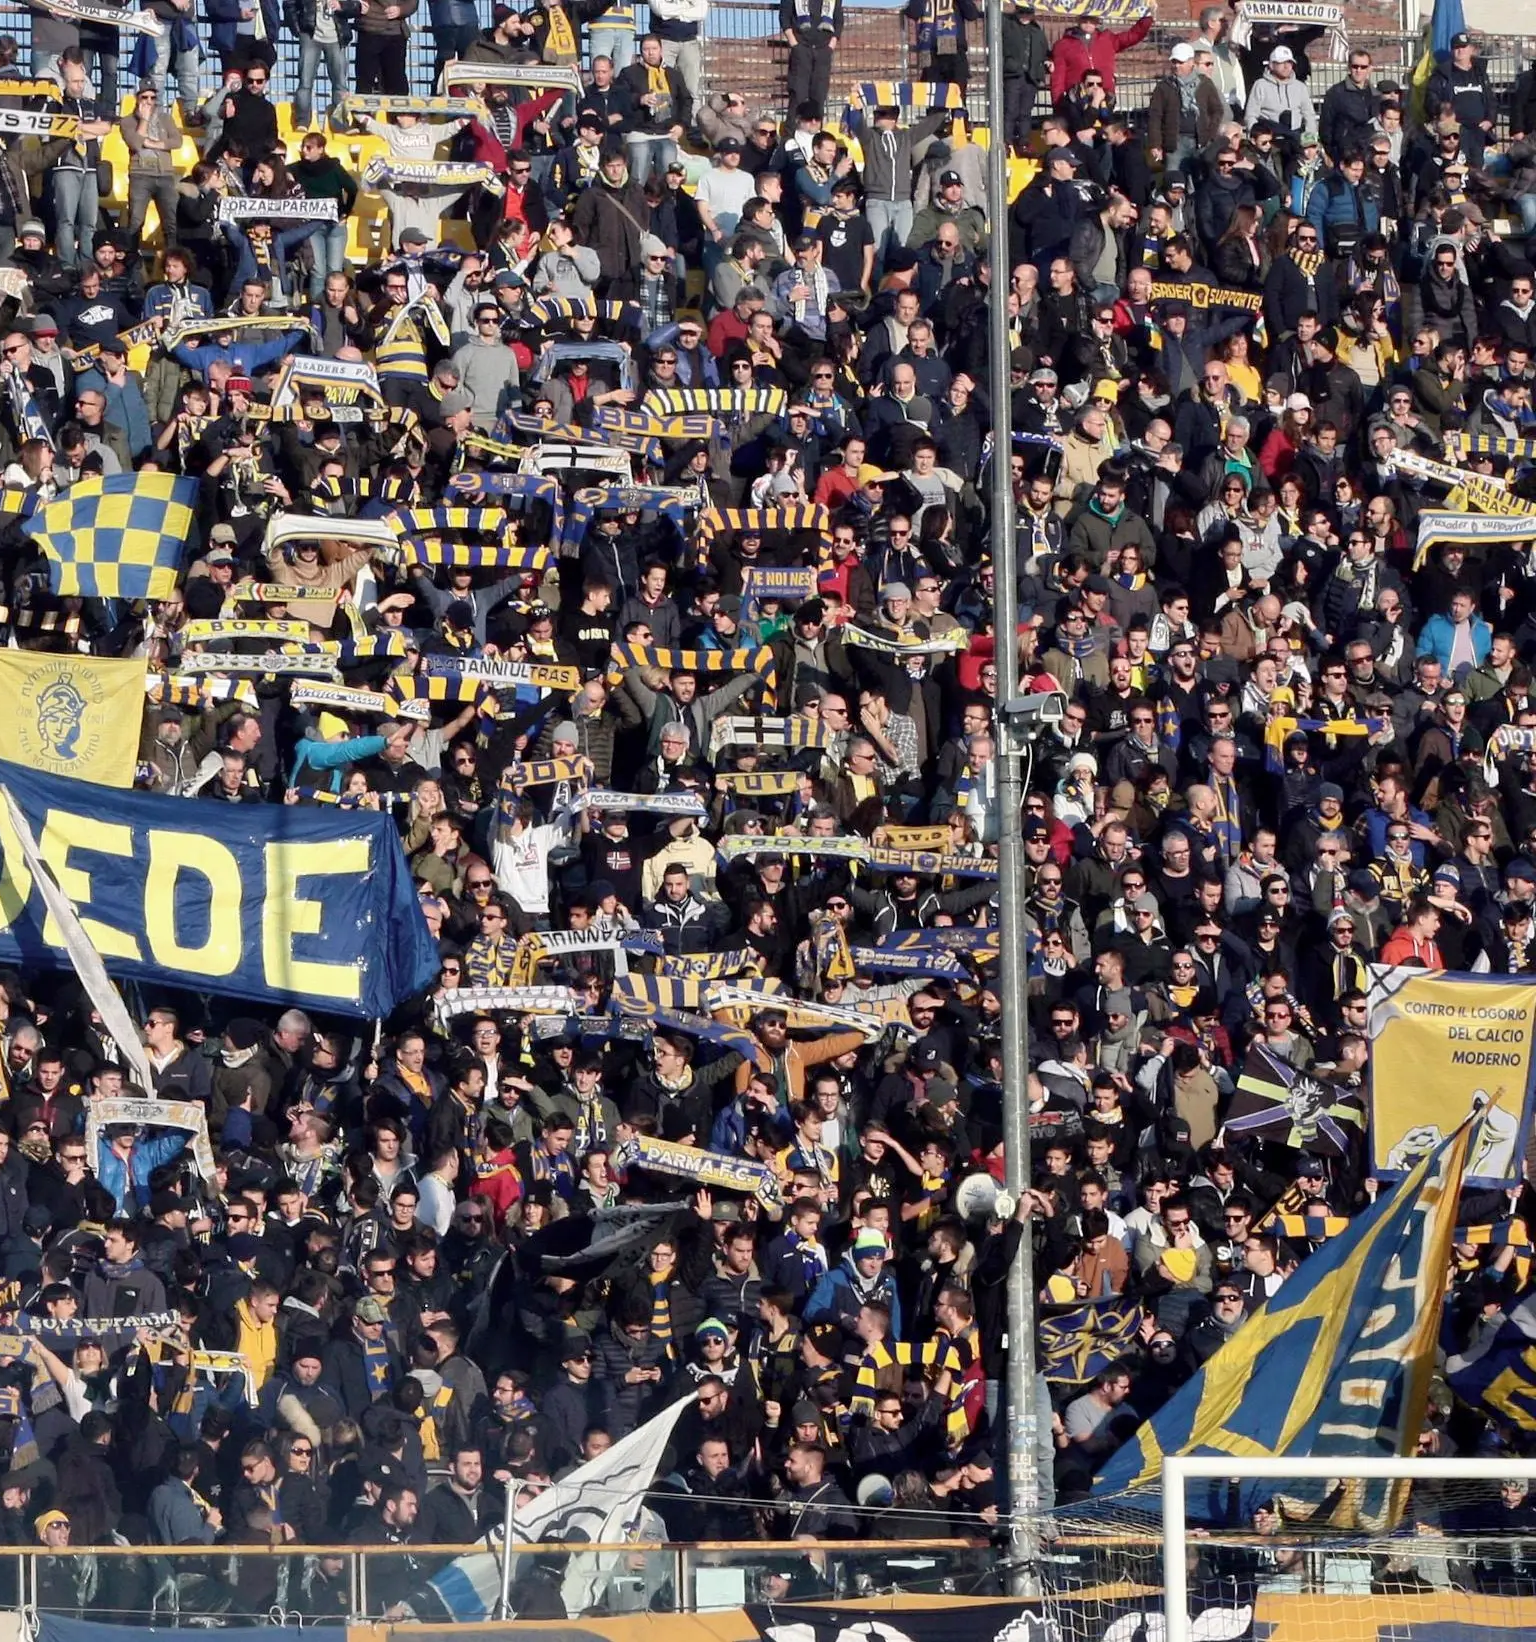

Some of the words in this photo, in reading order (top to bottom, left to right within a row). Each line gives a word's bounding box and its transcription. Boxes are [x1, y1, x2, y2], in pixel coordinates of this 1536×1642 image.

[1244, 2, 1283, 16] PARMA
[1286, 3, 1324, 18] CALCIO
[393, 163, 442, 177] PARMA
[283, 199, 329, 212] PARMA
[602, 408, 708, 437] BOYS
[210, 620, 290, 633] BOYS
[467, 659, 508, 677] ANNI
[509, 663, 570, 684] ULTRAS
[1404, 1001, 1456, 1019] CONTRO
[1471, 1006, 1528, 1021] LOGORIO
[1448, 1027, 1472, 1040] DEL
[1475, 1028, 1524, 1043] CALCIO
[1452, 1050, 1521, 1067] MODERNO
[645, 1147, 714, 1177] PARMA
